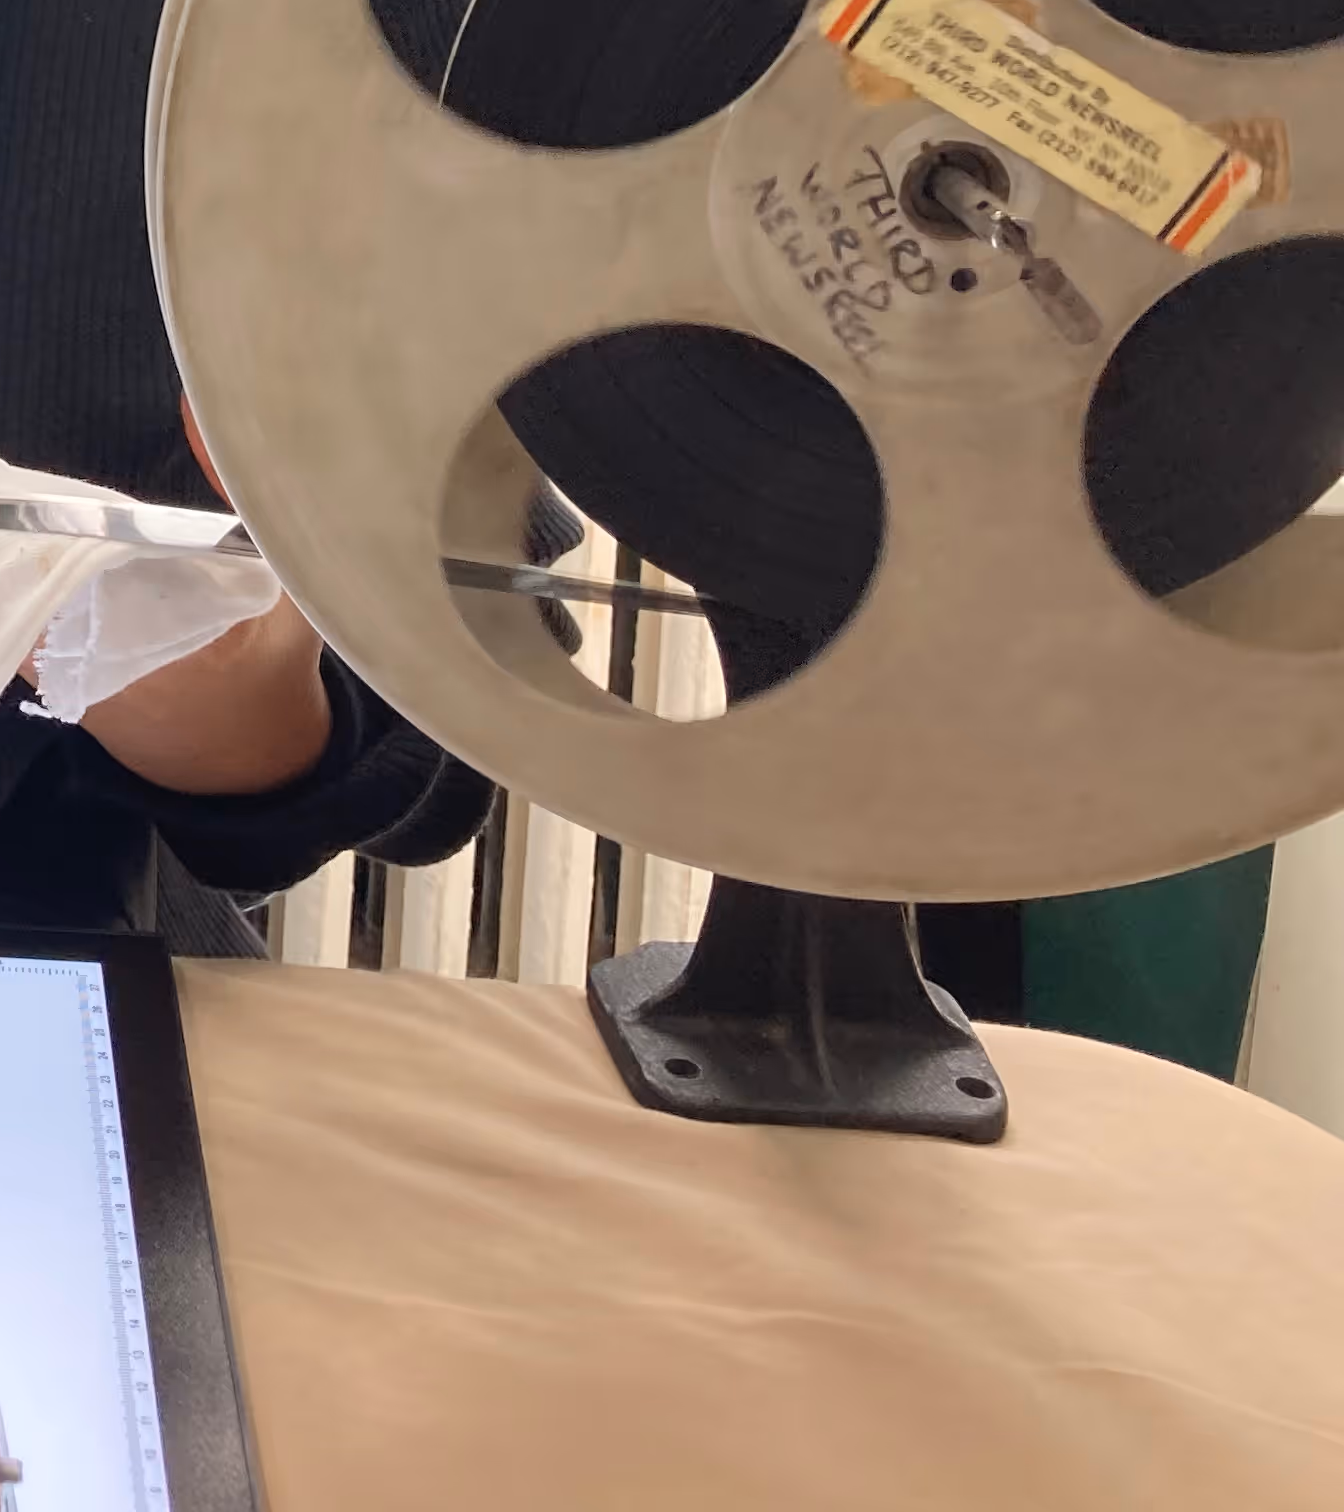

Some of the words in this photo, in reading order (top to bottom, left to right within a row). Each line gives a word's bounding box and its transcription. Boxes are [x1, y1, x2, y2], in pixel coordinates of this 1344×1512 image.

[927, 10, 990, 57] THIRD
[989, 48, 1062, 99] WORLD
[1061, 91, 1166, 163] NEWSREEL
[801, 161, 889, 312] WORLD
[844, 146, 933, 291] THIRD
